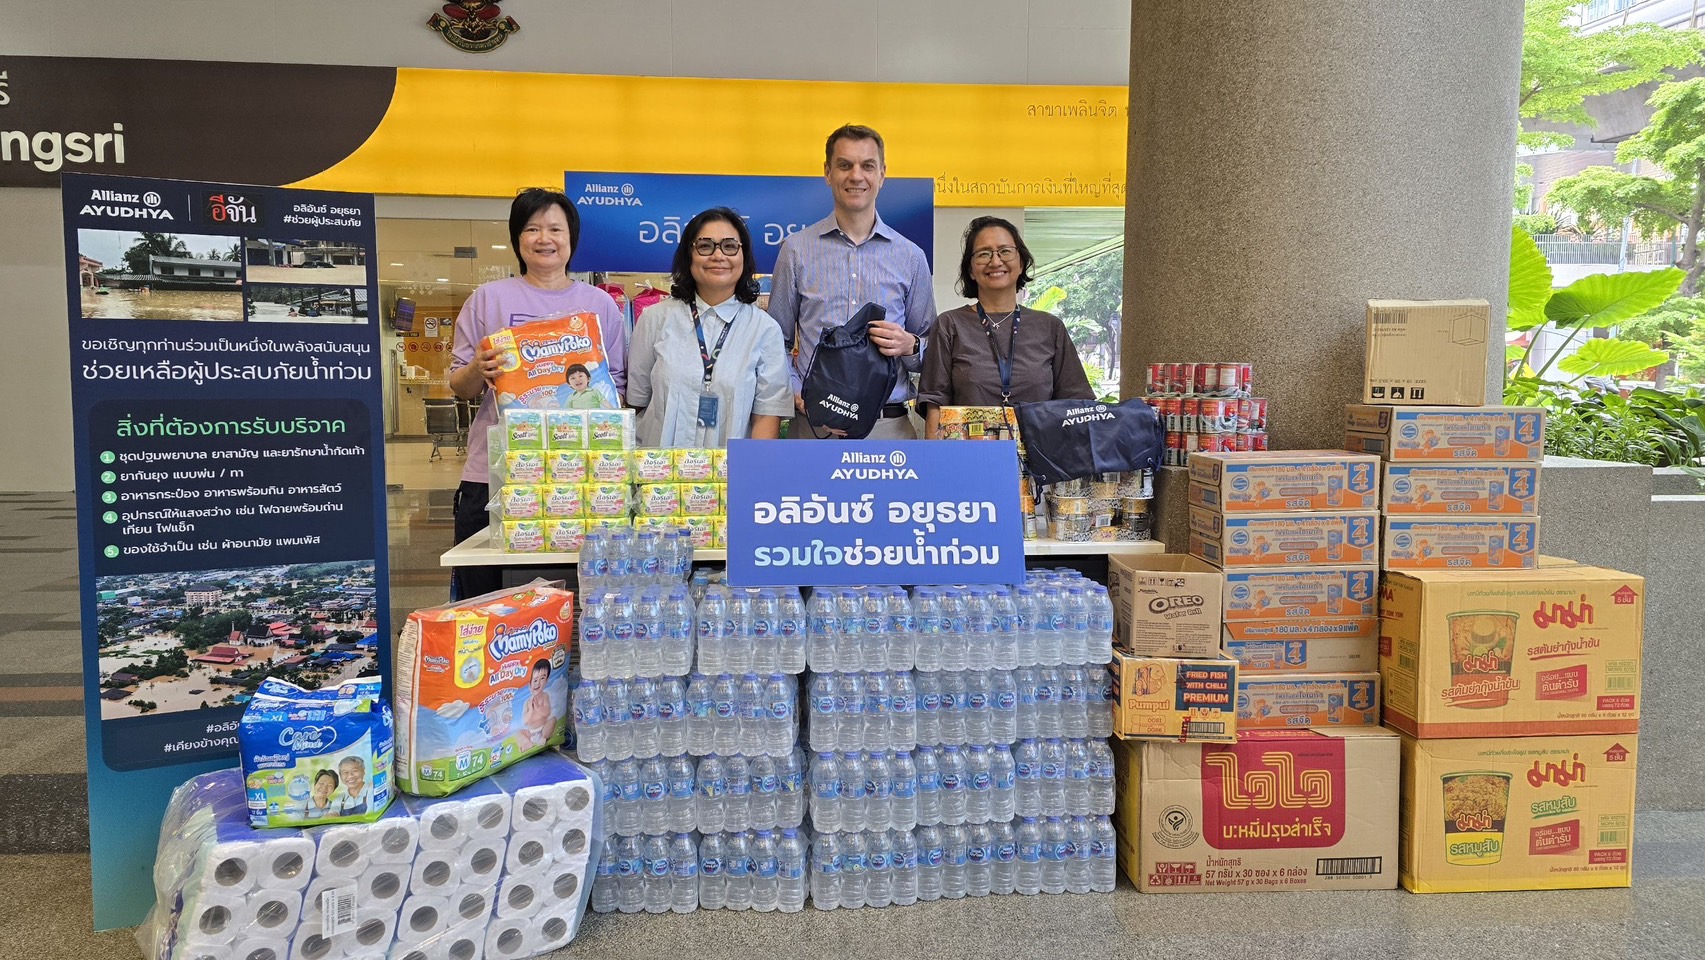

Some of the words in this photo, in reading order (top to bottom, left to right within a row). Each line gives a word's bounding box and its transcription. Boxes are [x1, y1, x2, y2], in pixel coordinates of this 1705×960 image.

[1027, 99, 1117, 117] สาขาเพลินจิต
[0, 122, 125, 172] ngsri
[91, 190, 139, 203] Allianz
[584, 183, 619, 194] Allianz
[577, 196, 643, 206] AYUDHYA
[80, 205, 174, 220] AYUDHYA
[211, 195, 257, 224] อีจัน
[293, 203, 327, 214] อลิอันซ์
[330, 206, 361, 217] อยุธยา
[283, 214, 362, 228] #ช่วยผู้ประสบภัย
[82, 337, 370, 356] ขอเชิญทุกท่านร่วมเป็นหนึ่งในพลังสนับสนุน
[520, 335, 592, 362] MamyPoko
[82, 356, 371, 385] ช่วยเหลือผู้ประสบภัยน้ำท่วม
[827, 393, 851, 409] Allianz
[819, 399, 859, 421] AYUDHYA
[1066, 405, 1094, 417] Allianz
[116, 414, 346, 437] สิ่งที่ต้องการรับบริจาค
[1061, 412, 1116, 428] AYUDHYA
[1519, 421, 1535, 437] 4
[120, 451, 207, 463] ชุดปฐมพยาบาล
[212, 448, 259, 460] ยาสามัญ
[263, 444, 365, 458] และยารักษาน้ำกัดเท้า
[841, 452, 886, 464] Allianz
[120, 471, 168, 482] ยากันยุง
[173, 468, 215, 479] แบบพ่น
[220, 468, 226, 478] /
[230, 469, 244, 478] ทา
[831, 468, 919, 480] AYUDHYA
[1352, 470, 1368, 486] 4
[1513, 475, 1528, 491] 4
[121, 488, 200, 501] อาหารกระป๋อง
[204, 486, 284, 498] อาหารพร้อมกิน
[288, 483, 342, 495] อาหารสัตว์
[122, 506, 232, 523] อุปกรณ์ให้แสงสว่าง
[236, 505, 255, 516] เช่น
[259, 502, 343, 515] ไฟฉายพร้อมถ่าน
[754, 493, 875, 525] อลิอันซ์
[888, 500, 997, 533] อยุธยา
[122, 523, 152, 535] เทียน
[156, 520, 195, 533] ไฟแช็ก
[1352, 525, 1367, 541] 4
[123, 541, 194, 555] ของใช้จำเป็น
[198, 540, 218, 550] เช่น
[222, 537, 272, 549] ผ้าอนามัย
[1513, 531, 1528, 546] 4
[754, 529, 1000, 567] รวมใจช่วยน้ำท่วม
[1351, 579, 1367, 595] 4
[1149, 595, 1204, 614] OREO
[1533, 593, 1594, 629] มาม่า
[1275, 625, 1288, 634] 180
[489, 618, 559, 662] MamyPoko
[1527, 636, 1600, 656] รสต้มยำกุ้งน้ำข้น
[500, 669, 514, 680] Day
[514, 667, 527, 678] Dry
[1186, 671, 1208, 679] FRIED
[1209, 671, 1228, 680] FISH
[1186, 682, 1204, 690] WITH
[1205, 682, 1228, 691] CHILLI
[1183, 692, 1229, 704] PREMIUM
[1352, 688, 1369, 705] 4
[1128, 699, 1170, 712] Pumpui
[279, 726, 322, 747] Care
[472, 753, 484, 769] 74
[1527, 753, 1586, 788] มาม่า
[254, 792, 266, 801] XL
[1531, 795, 1577, 814] รสหมูสับ
[1450, 837, 1499, 857] รสหมูสับ
[1205, 869, 1216, 879] 57
[1218, 867, 1234, 879] กรัม
[1235, 870, 1241, 878] x
[1243, 868, 1253, 878] 30
[1272, 869, 1278, 877] x
[1280, 867, 1285, 877] 6
[1287, 865, 1308, 877] กล่อง
